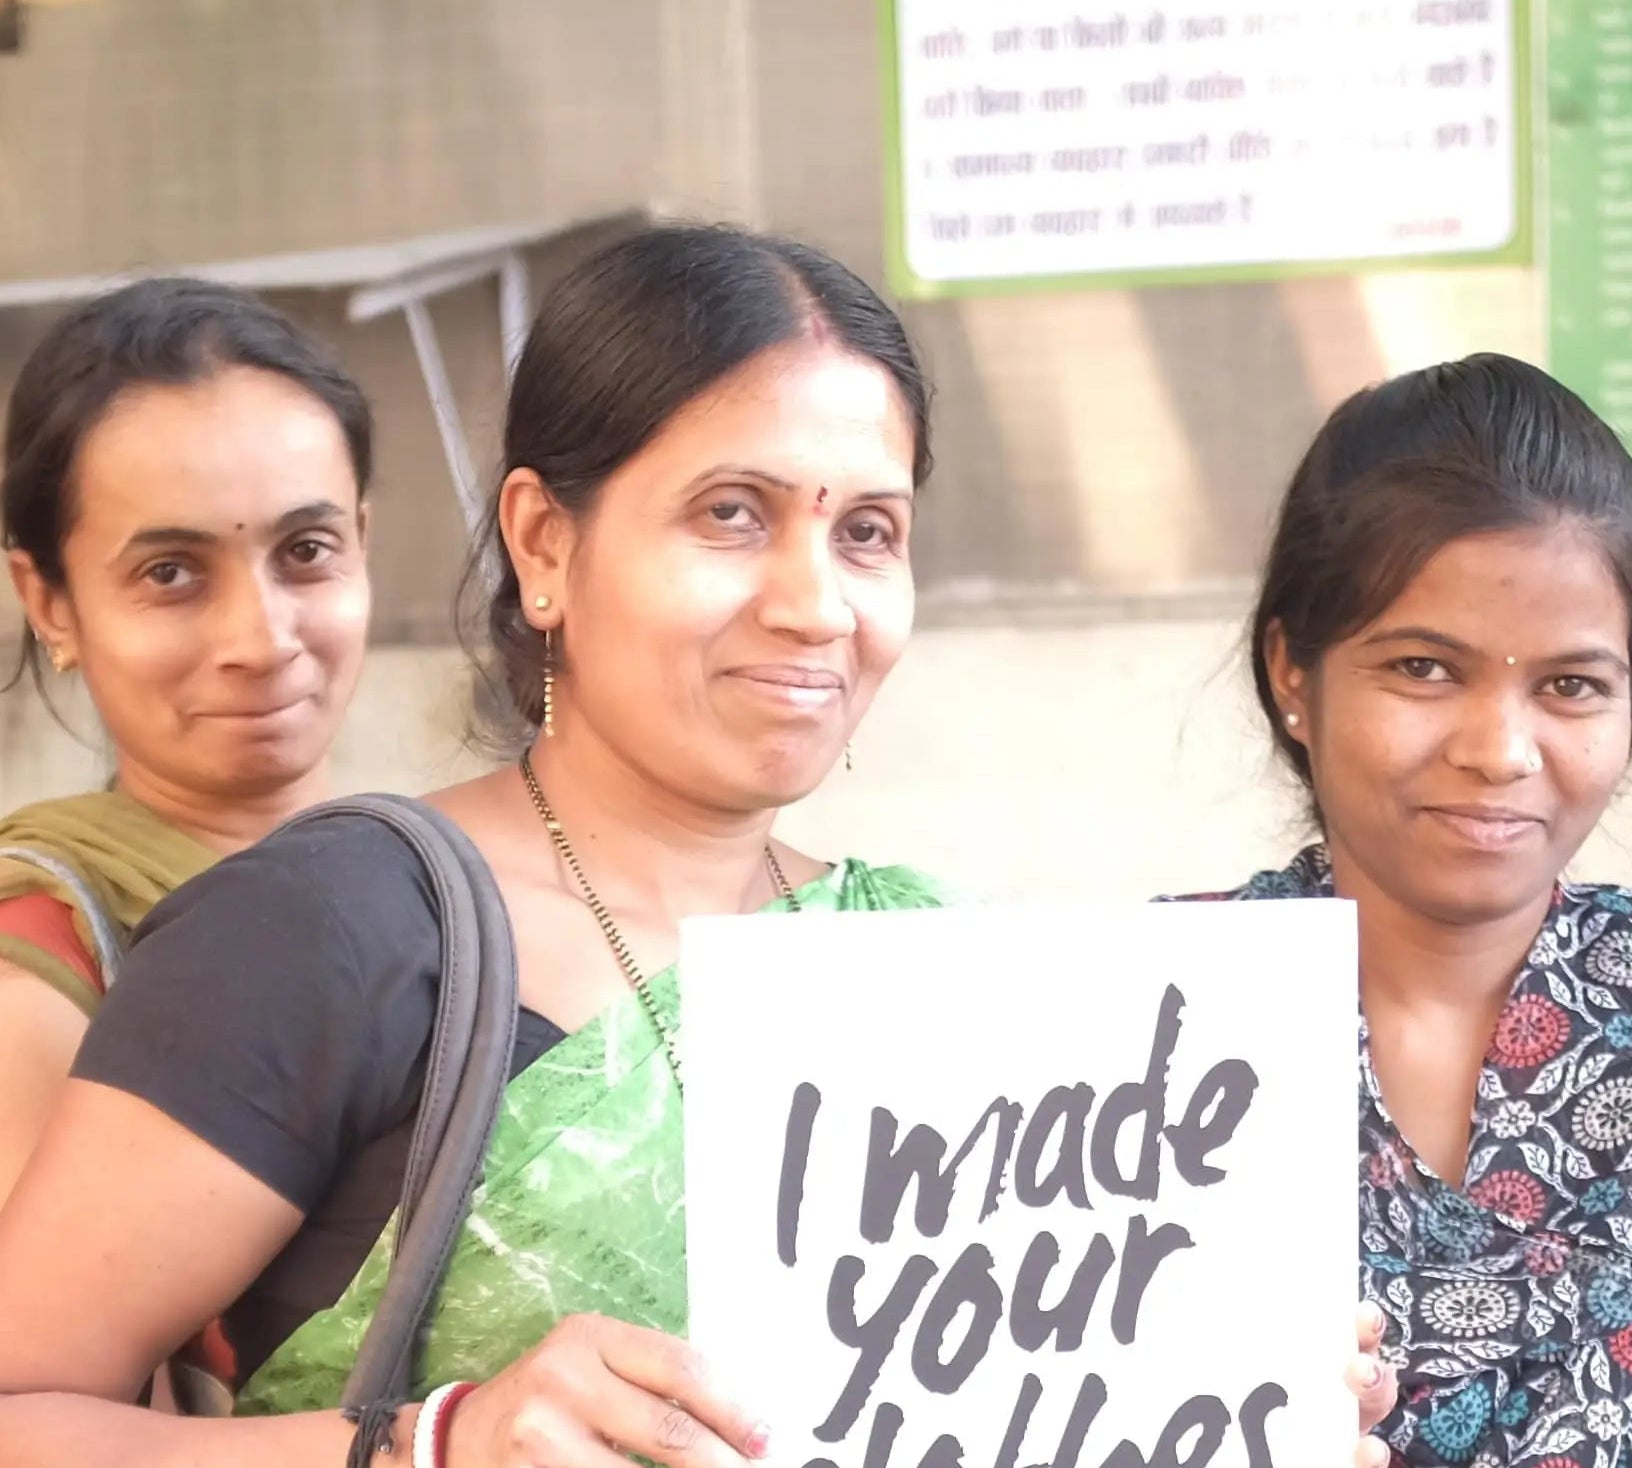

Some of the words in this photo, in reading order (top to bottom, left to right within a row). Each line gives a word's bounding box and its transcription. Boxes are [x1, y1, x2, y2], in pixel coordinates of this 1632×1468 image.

[776, 1080, 823, 1268] I
[858, 982, 1261, 1246] made
[811, 1212, 1197, 1444] your
